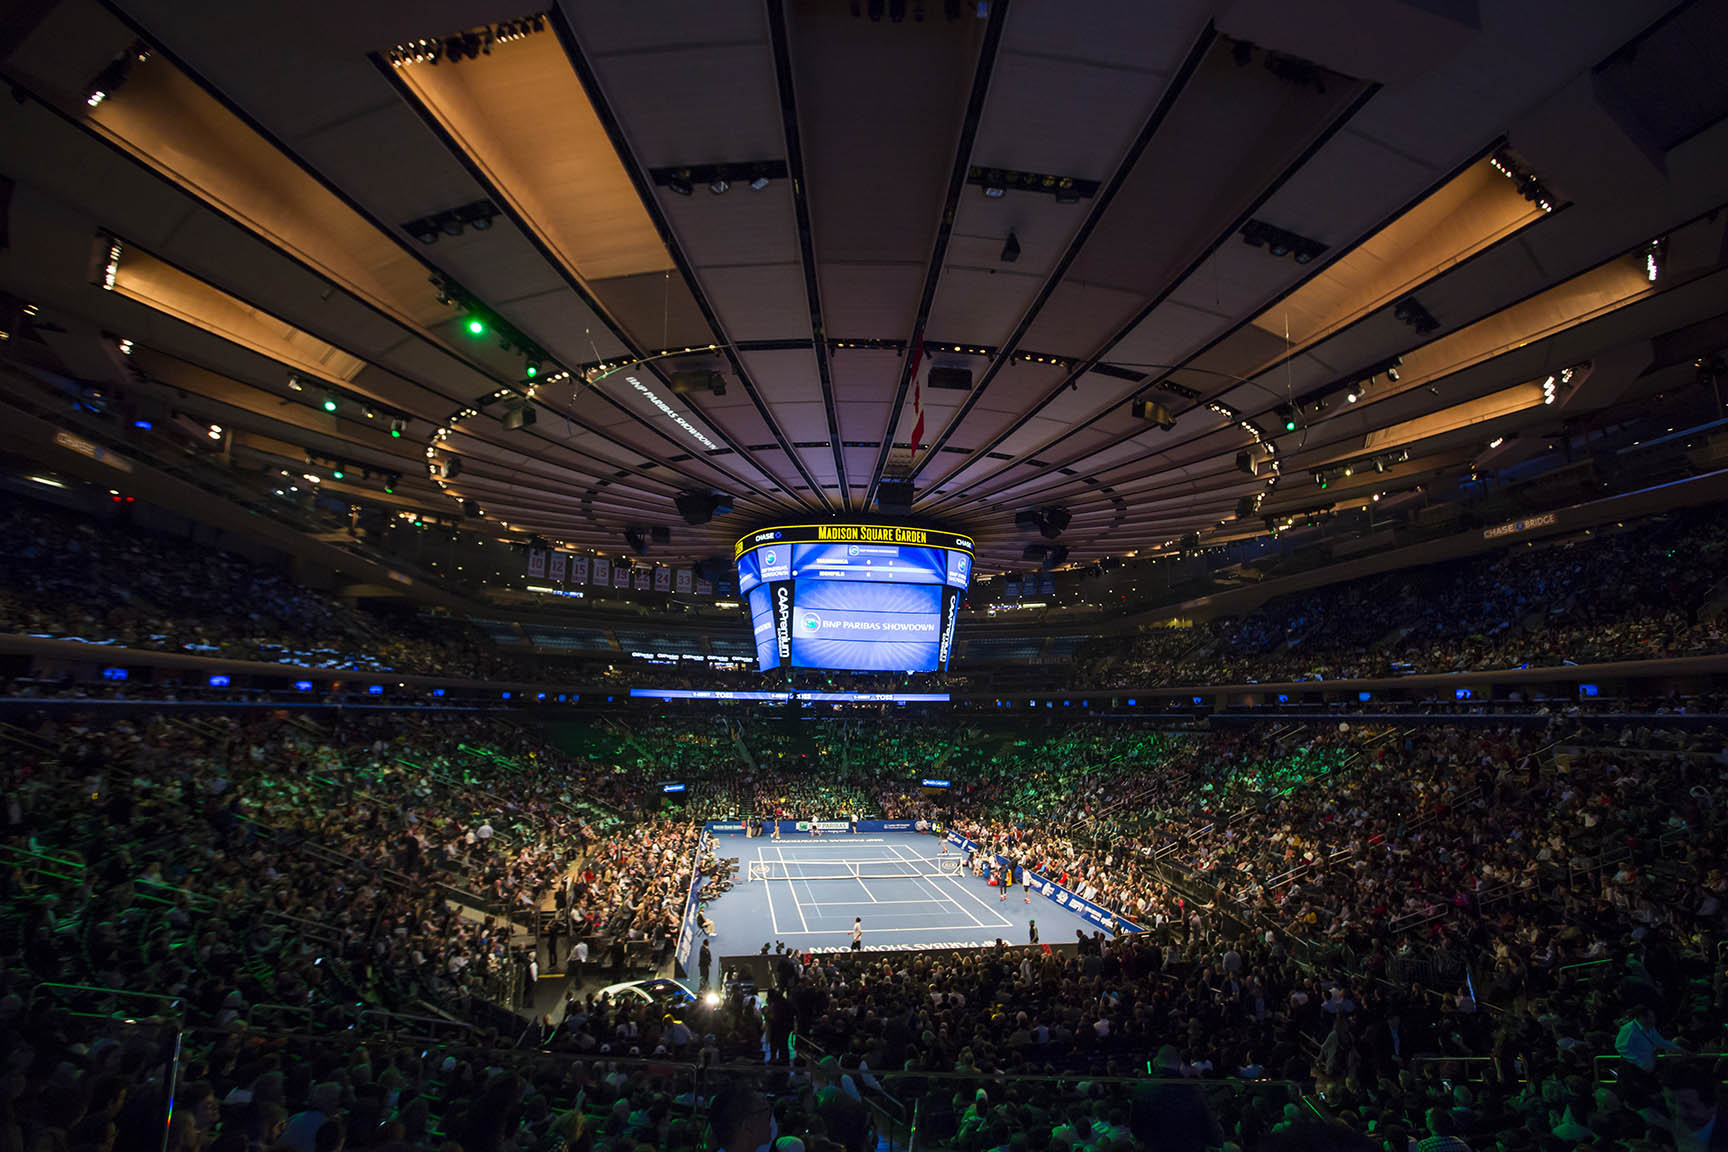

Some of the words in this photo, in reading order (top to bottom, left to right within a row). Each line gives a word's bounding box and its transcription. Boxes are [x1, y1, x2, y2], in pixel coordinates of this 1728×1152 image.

[818, 526, 858, 540] MADISON
[860, 526, 894, 541] SQUARE
[895, 528, 927, 544] GARDEN
[1483, 525, 1514, 538] CHASE
[1525, 514, 1556, 529] BRIDGE
[822, 620, 842, 629] BNP
[843, 621, 881, 630] PARIBAS
[882, 622, 935, 632] SHOWDOWN
